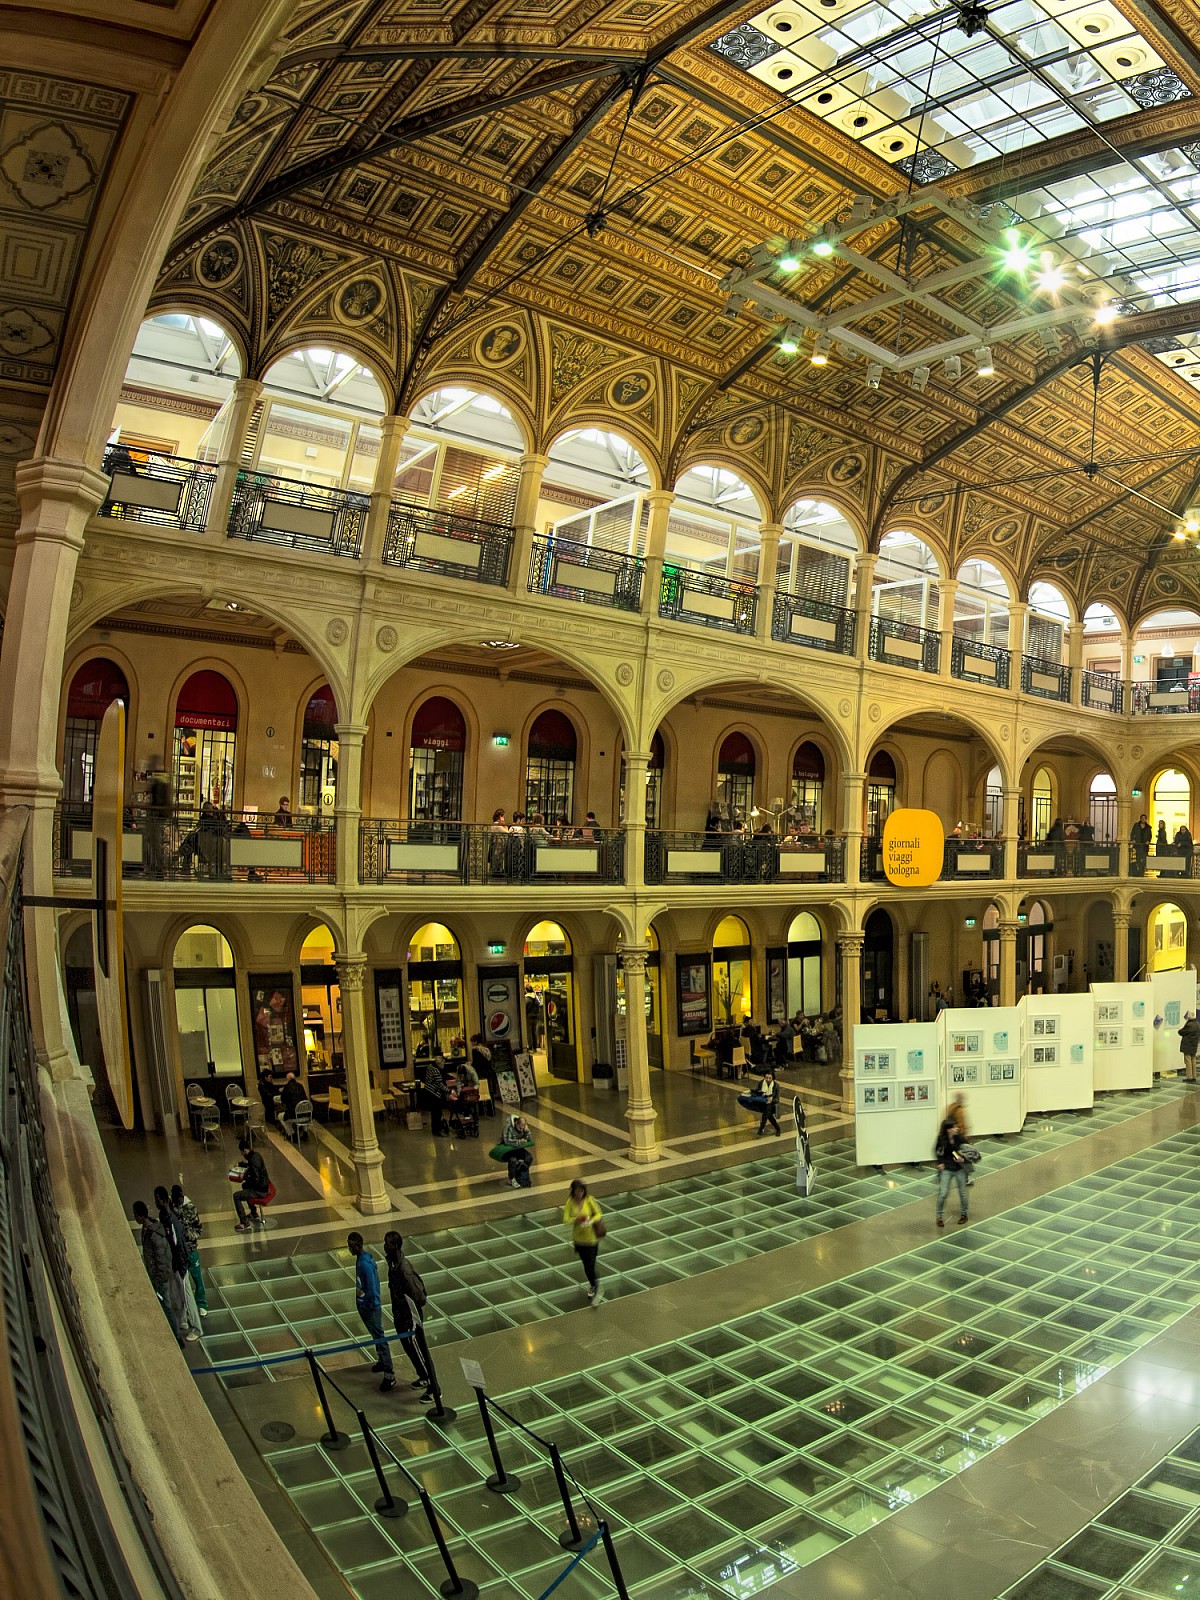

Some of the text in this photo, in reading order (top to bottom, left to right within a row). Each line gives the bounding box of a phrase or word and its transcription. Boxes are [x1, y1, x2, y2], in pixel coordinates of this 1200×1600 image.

[180, 715, 230, 727] documentari
[423, 738, 449, 747] viaggi
[888, 837, 920, 851] giornali
[888, 851, 913, 864] viaggi
[888, 864, 920, 877] bologna
